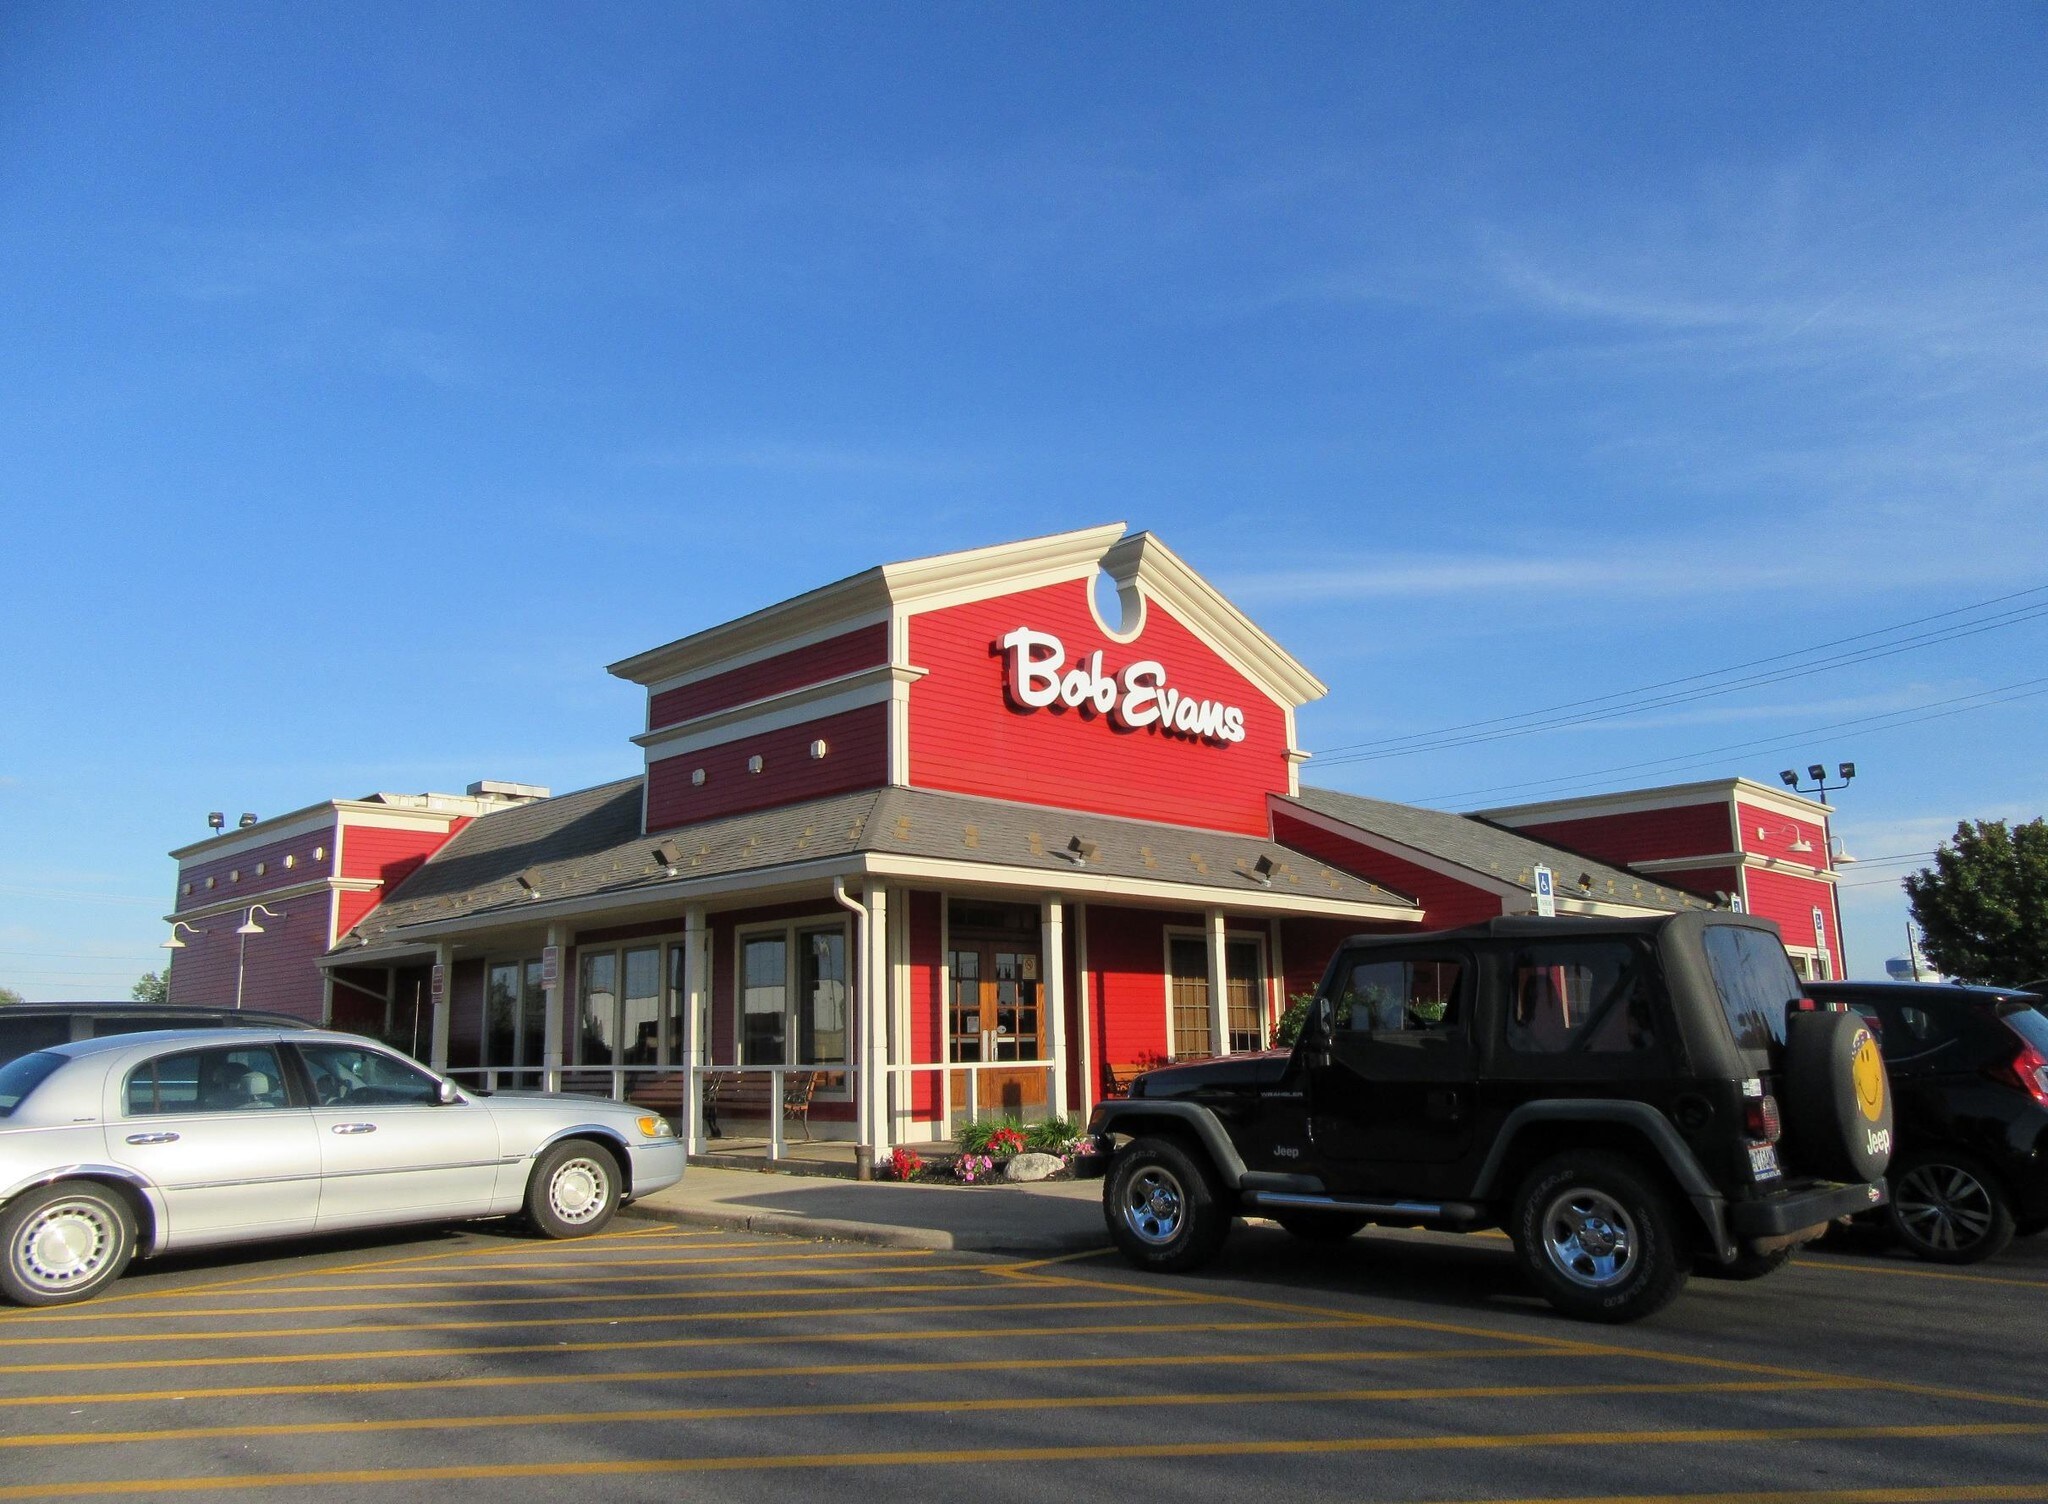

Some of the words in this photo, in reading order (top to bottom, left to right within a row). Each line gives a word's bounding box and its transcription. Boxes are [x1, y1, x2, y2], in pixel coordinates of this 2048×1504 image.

[1003, 626, 1118, 714] Bob
[1121, 660, 1246, 743] Evans
[1273, 1145, 1298, 1158] Jeep
[1867, 1129, 1890, 1155] Jeep
